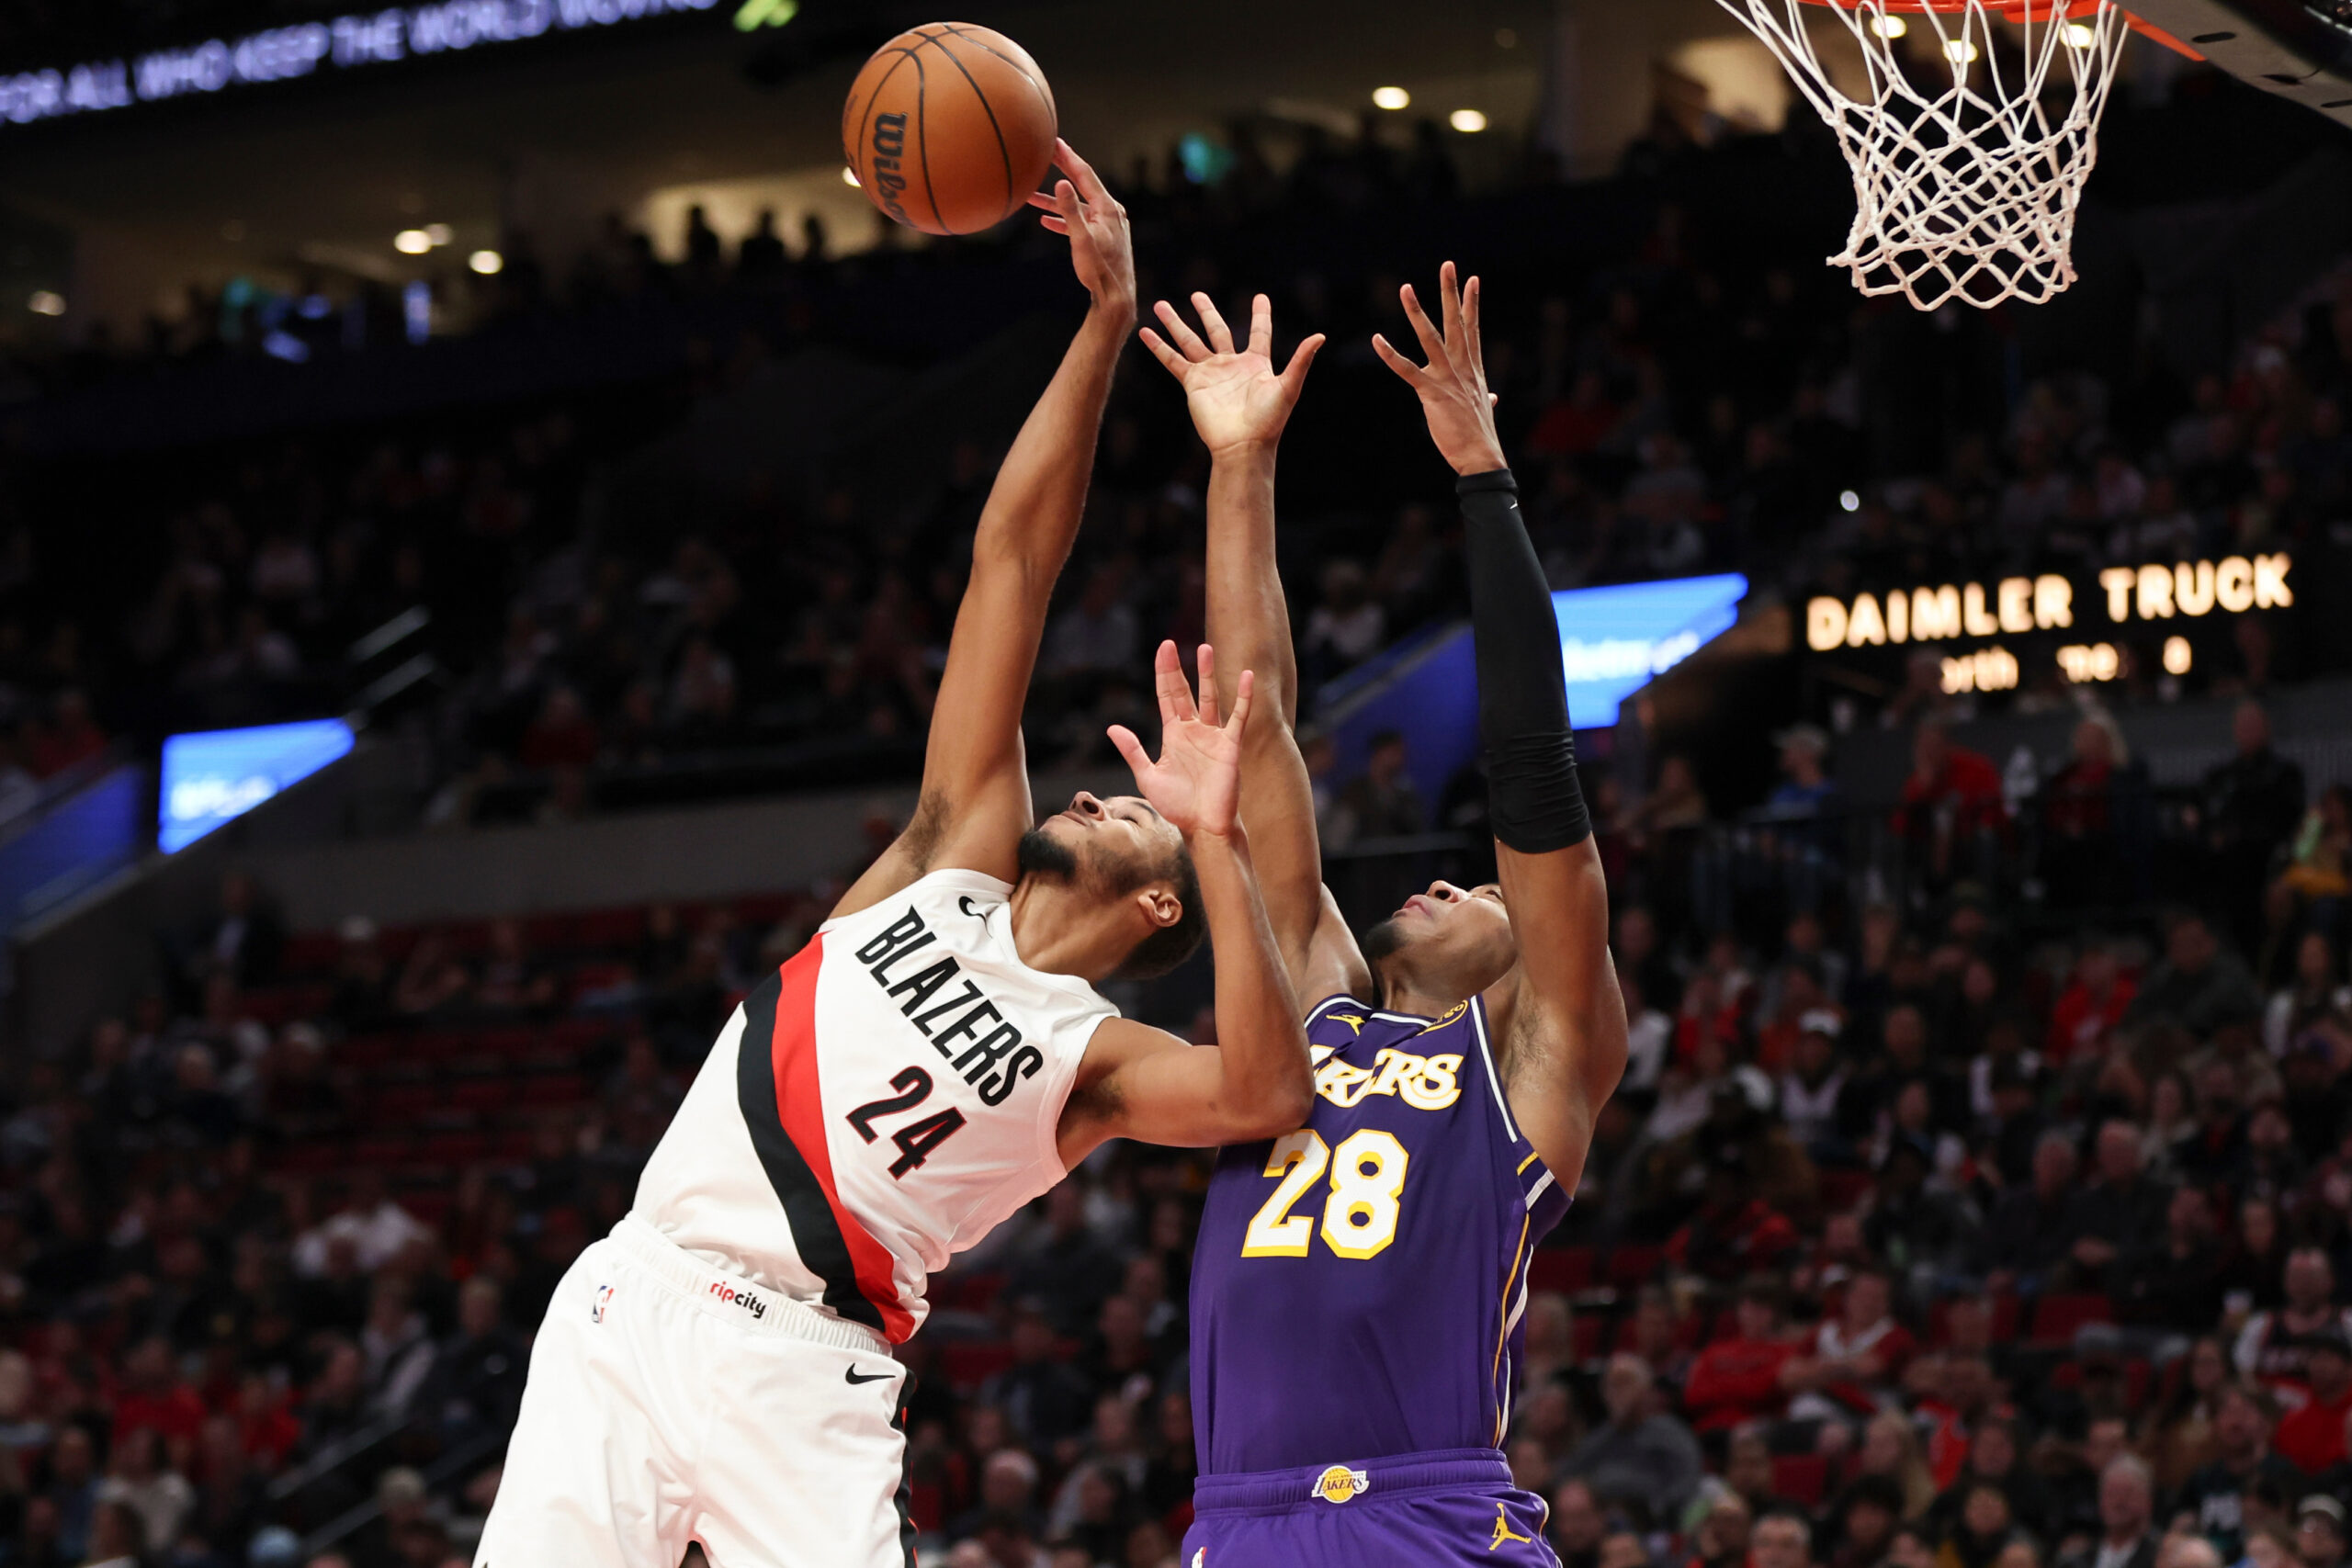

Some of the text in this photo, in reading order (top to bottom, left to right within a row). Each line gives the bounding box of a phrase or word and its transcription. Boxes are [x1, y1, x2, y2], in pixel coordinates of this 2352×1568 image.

[332, 7, 405, 66] THE
[1806, 551, 2293, 650] DAIMLER TRUCK
[854, 904, 1044, 1107] BLAZERS
[845, 1066, 967, 1181] 24
[1241, 1128, 1410, 1260] 28
[1314, 1475, 1367, 1496] LAKERS
